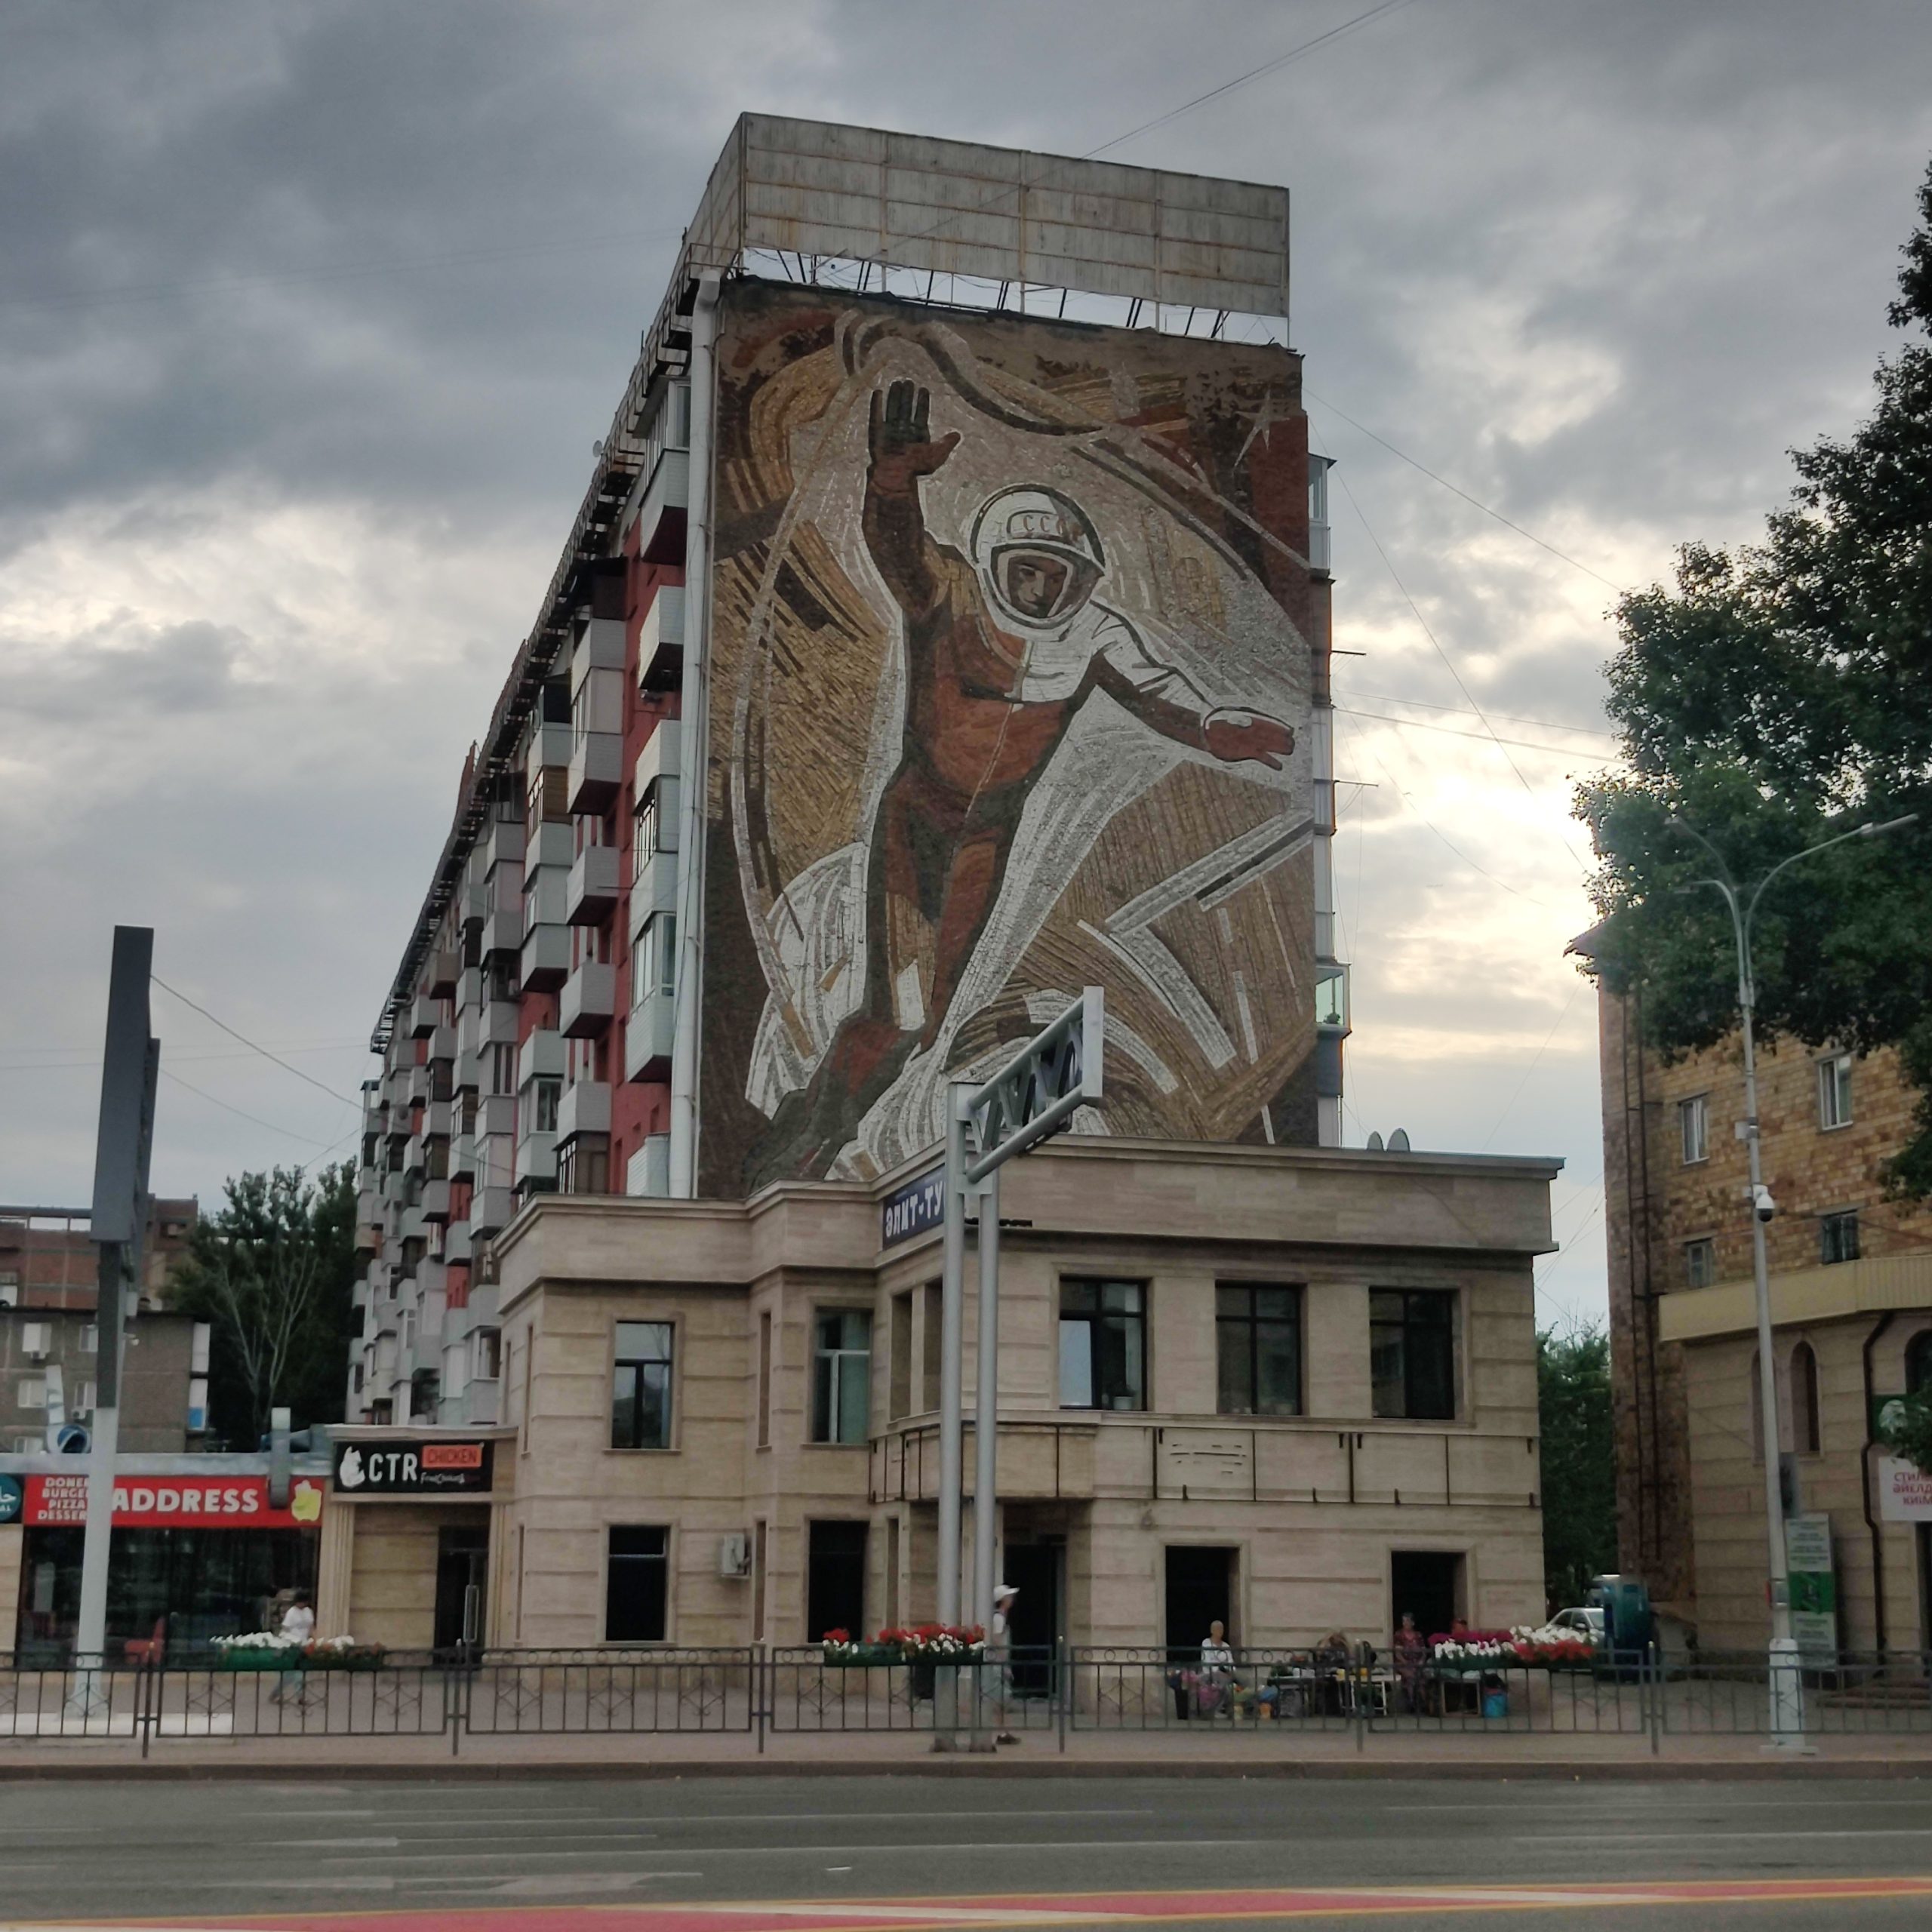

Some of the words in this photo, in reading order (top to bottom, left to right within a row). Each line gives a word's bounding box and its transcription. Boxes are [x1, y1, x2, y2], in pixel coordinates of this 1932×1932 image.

[886, 1180, 946, 1238] ЭЛИТ-ТУ
[368, 1453, 418, 1482] CTR
[428, 1448, 477, 1463] CHICKEN
[48, 1499, 85, 1509] PIZZA
[112, 1487, 259, 1512] ADDRESS
[38, 1510, 88, 1520] DESSER
